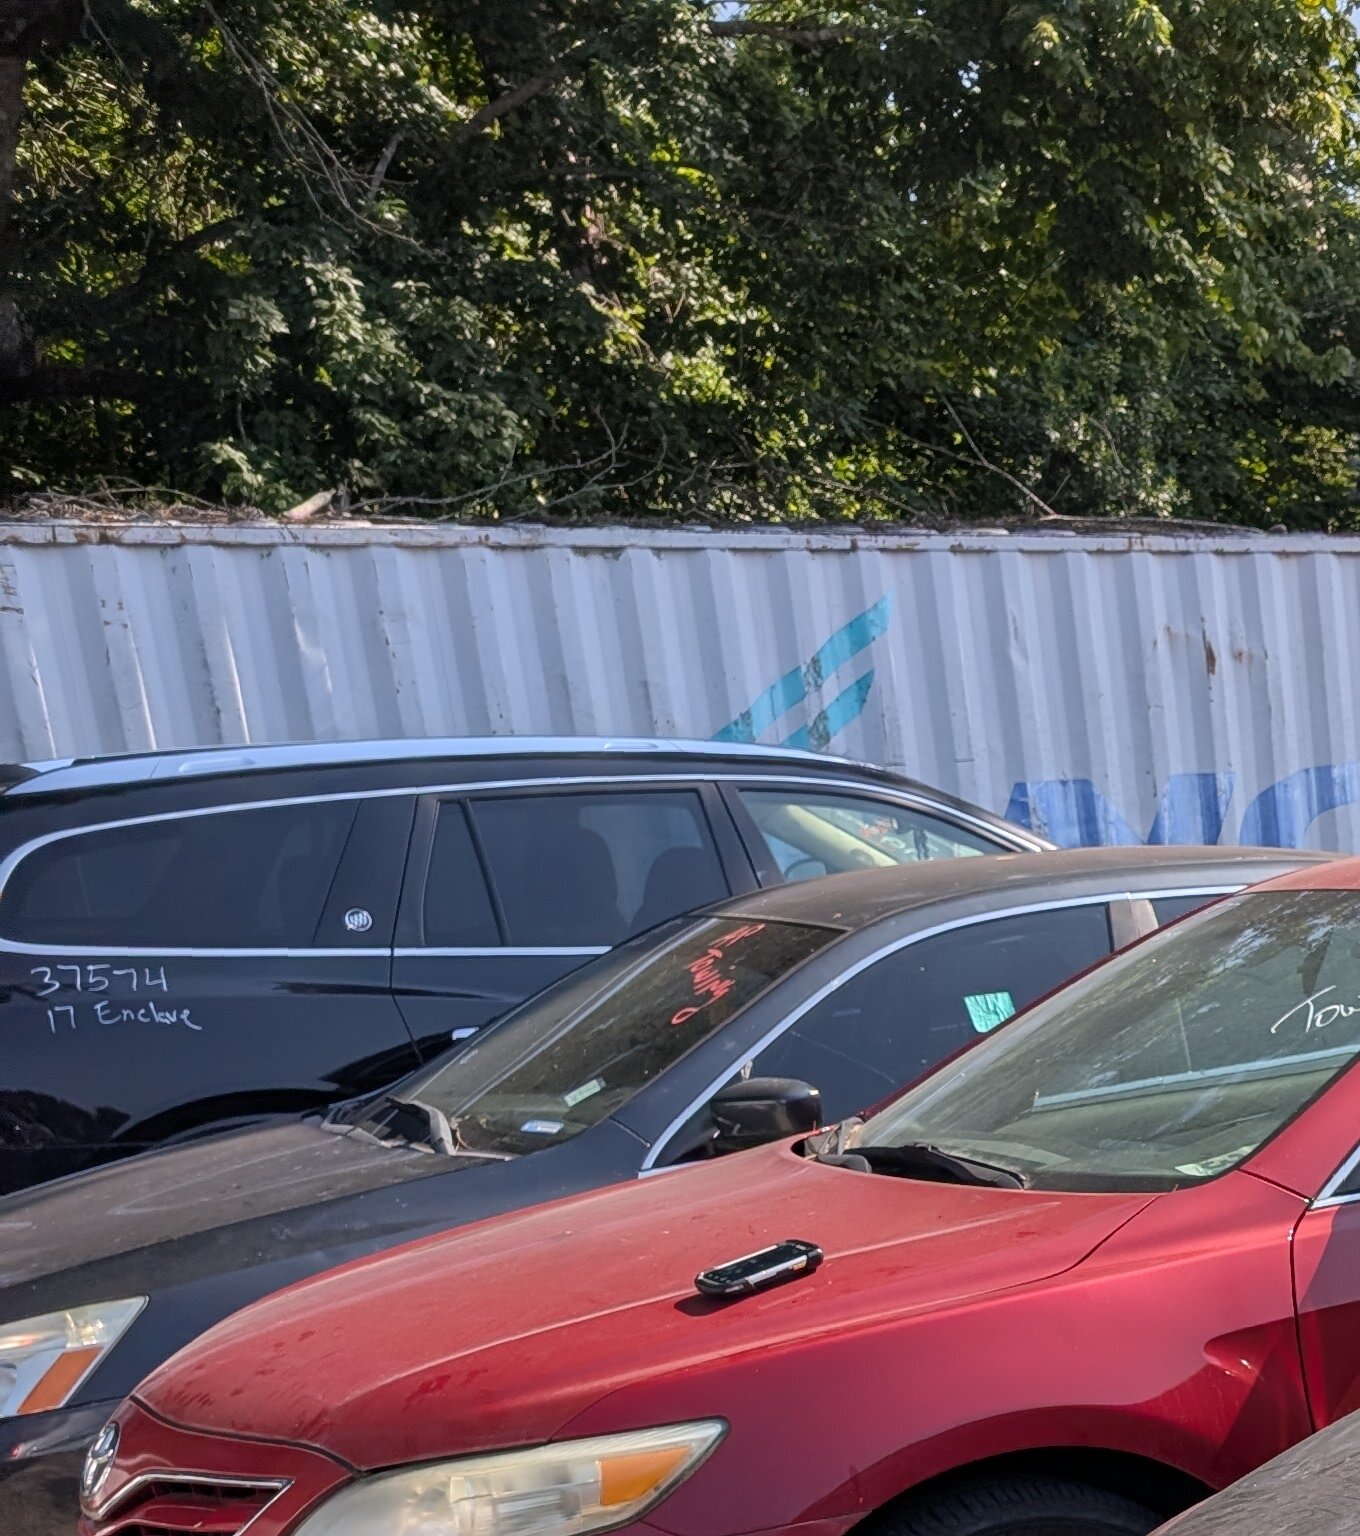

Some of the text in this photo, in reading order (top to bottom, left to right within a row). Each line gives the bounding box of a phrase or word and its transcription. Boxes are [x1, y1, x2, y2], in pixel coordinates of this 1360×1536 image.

[30, 964, 168, 997] 37574
[47, 1000, 203, 1034] 17 Enclave
